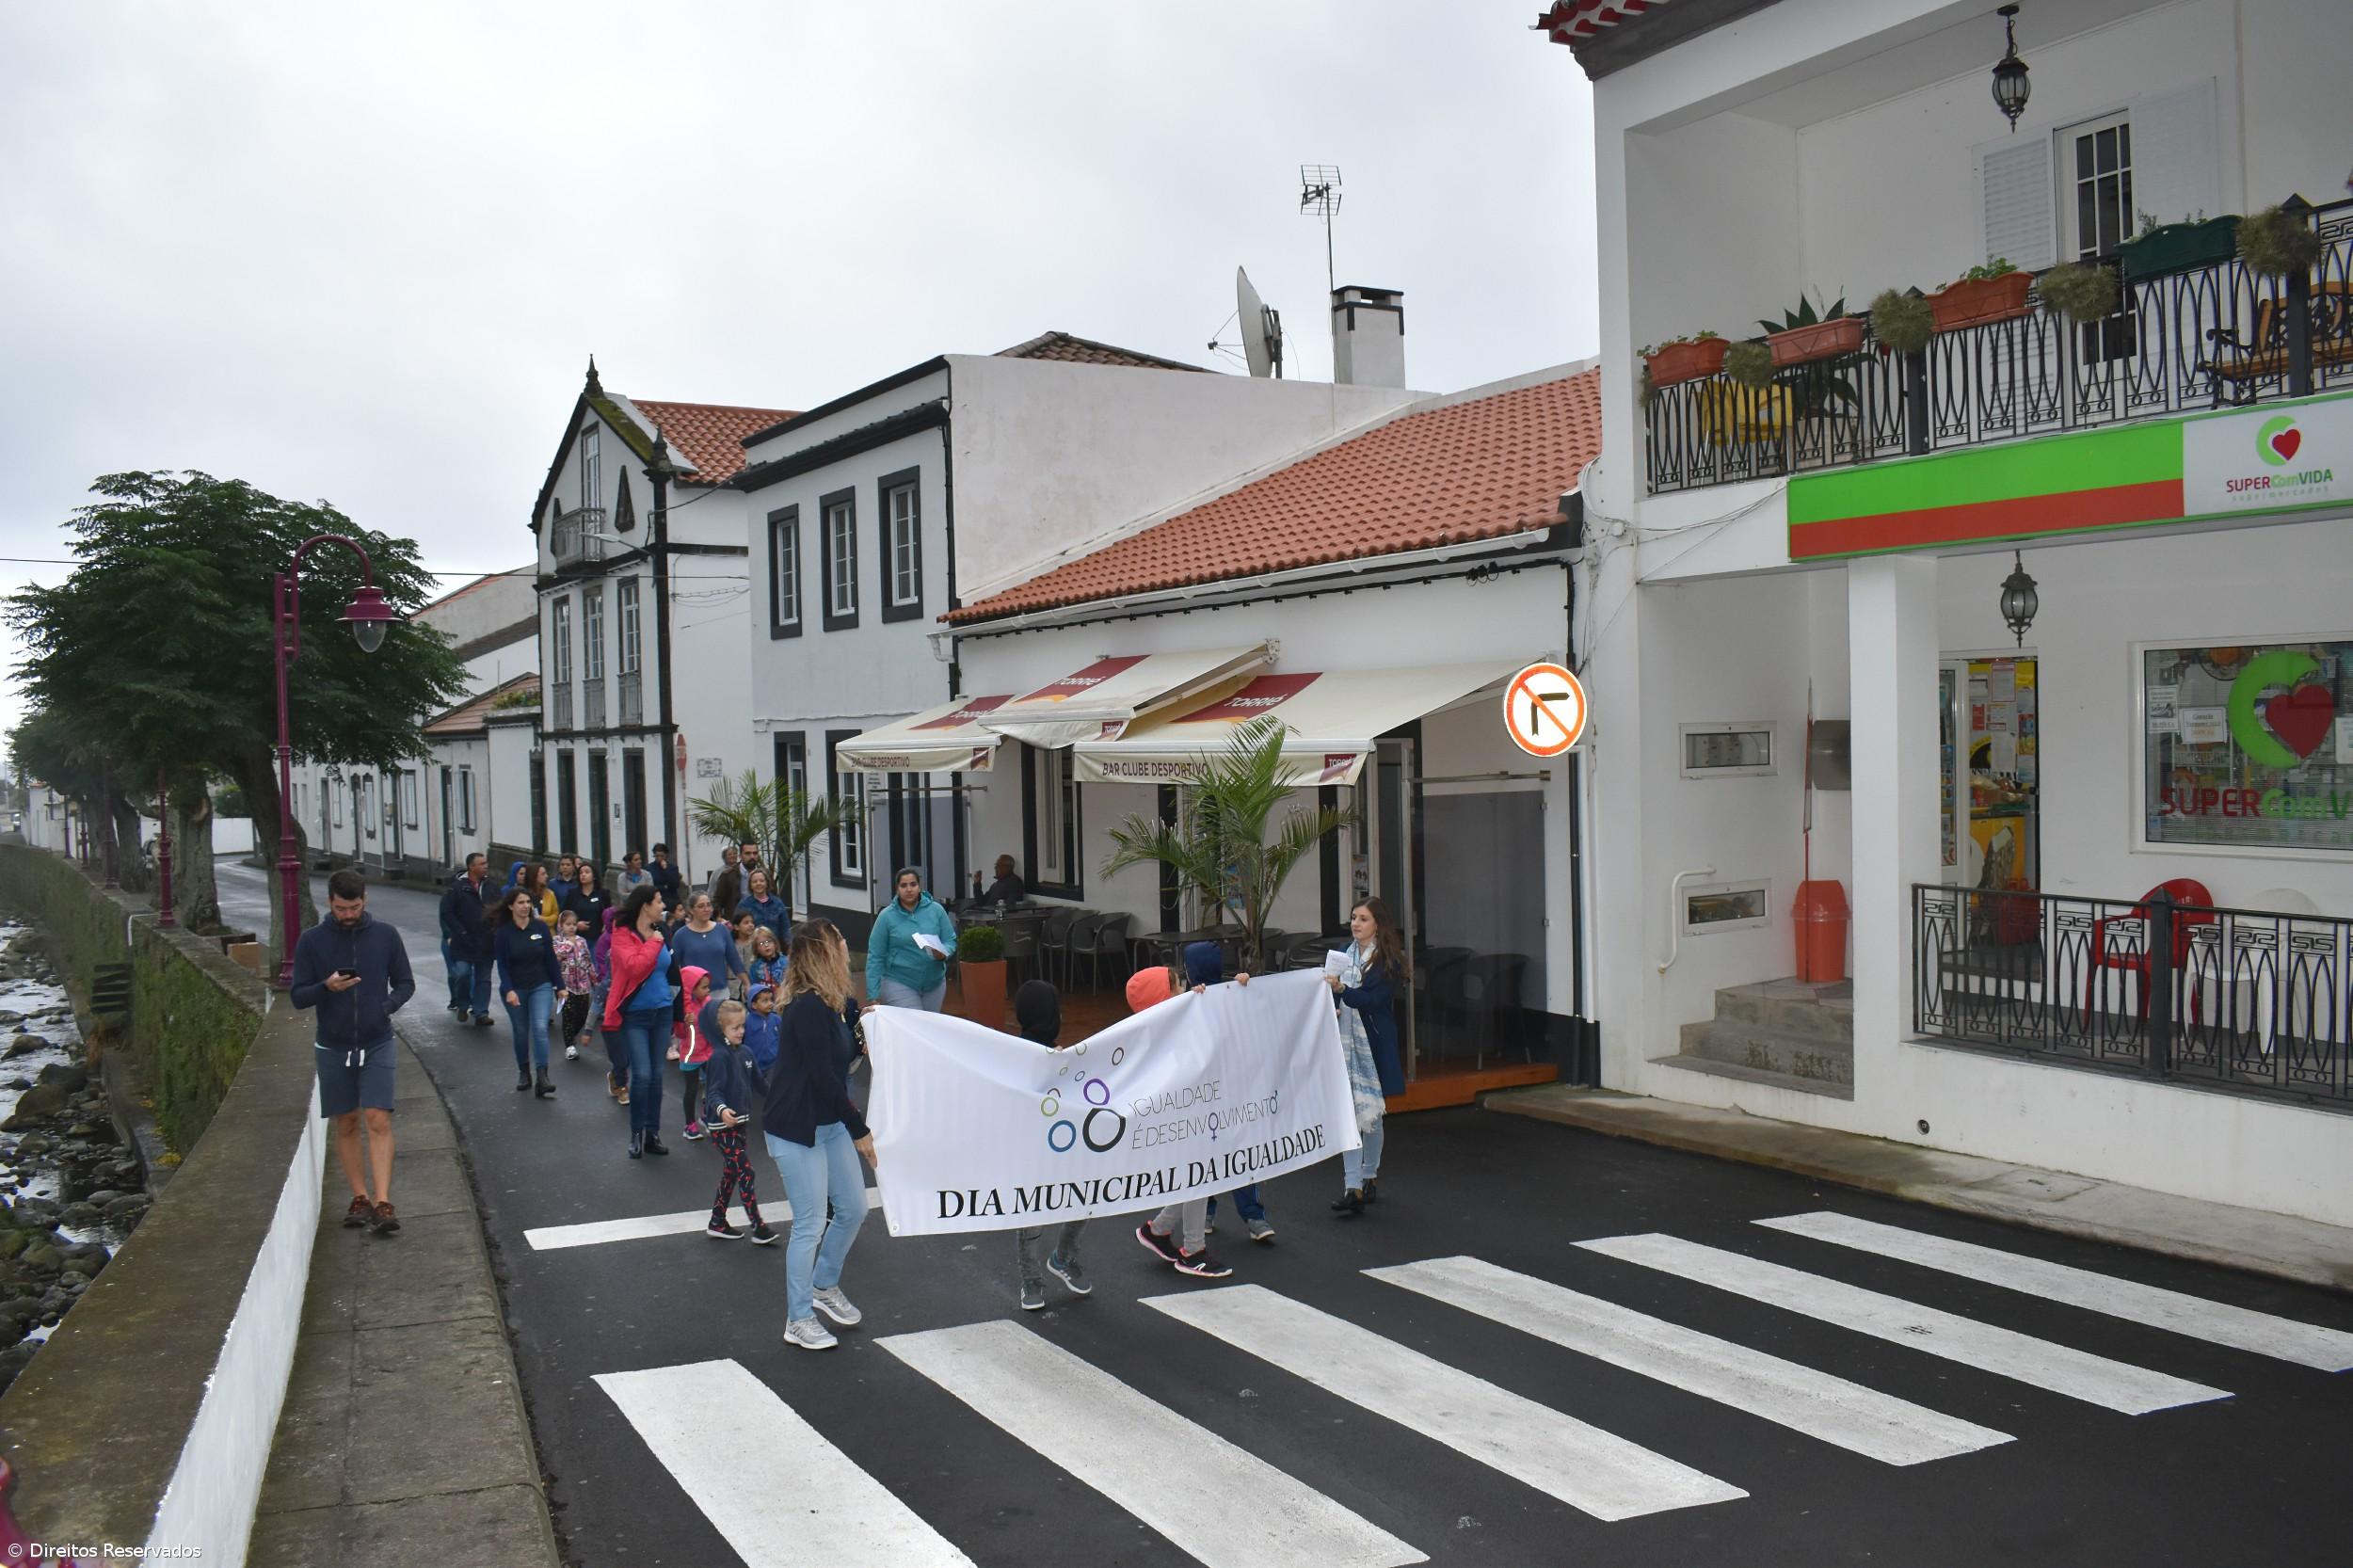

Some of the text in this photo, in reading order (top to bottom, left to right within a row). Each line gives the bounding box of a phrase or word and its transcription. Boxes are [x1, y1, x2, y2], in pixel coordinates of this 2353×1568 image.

[877, 756, 909, 768] DESPORTIVO
[1102, 762, 1120, 776] BAR
[1122, 762, 1148, 776] CLUBE
[1128, 1080, 1222, 1118] IGUALDADE
[1132, 1090, 1278, 1150] É DESENVOLVIMENTO
[937, 1124, 1326, 1219] DIA MUNICIPAL DA IGUALDADE
